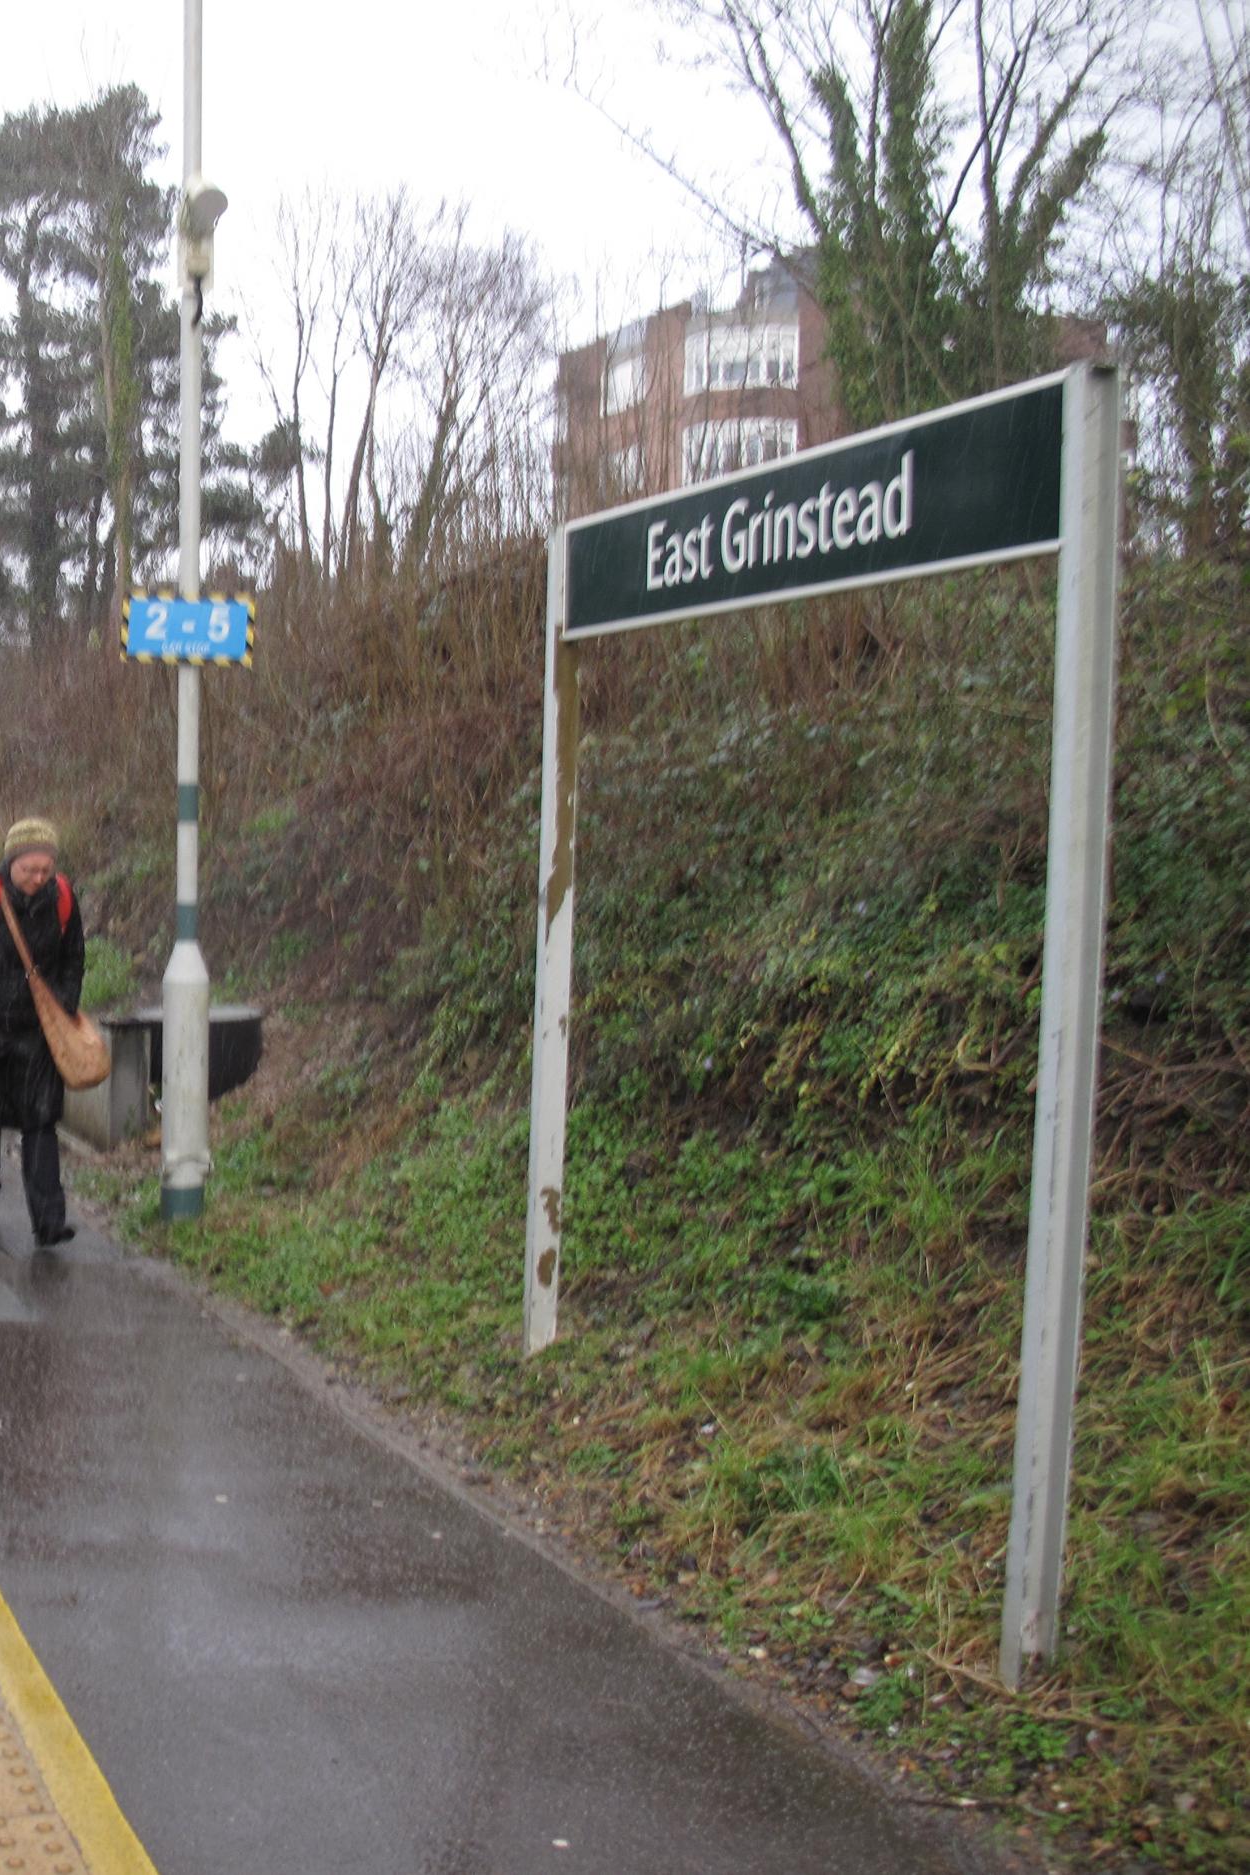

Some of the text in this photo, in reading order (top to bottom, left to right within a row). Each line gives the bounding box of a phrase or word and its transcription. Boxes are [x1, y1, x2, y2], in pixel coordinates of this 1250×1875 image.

[646, 449, 914, 591] East Grinstead
[146, 602, 167, 639] 2
[208, 605, 230, 642] 5
